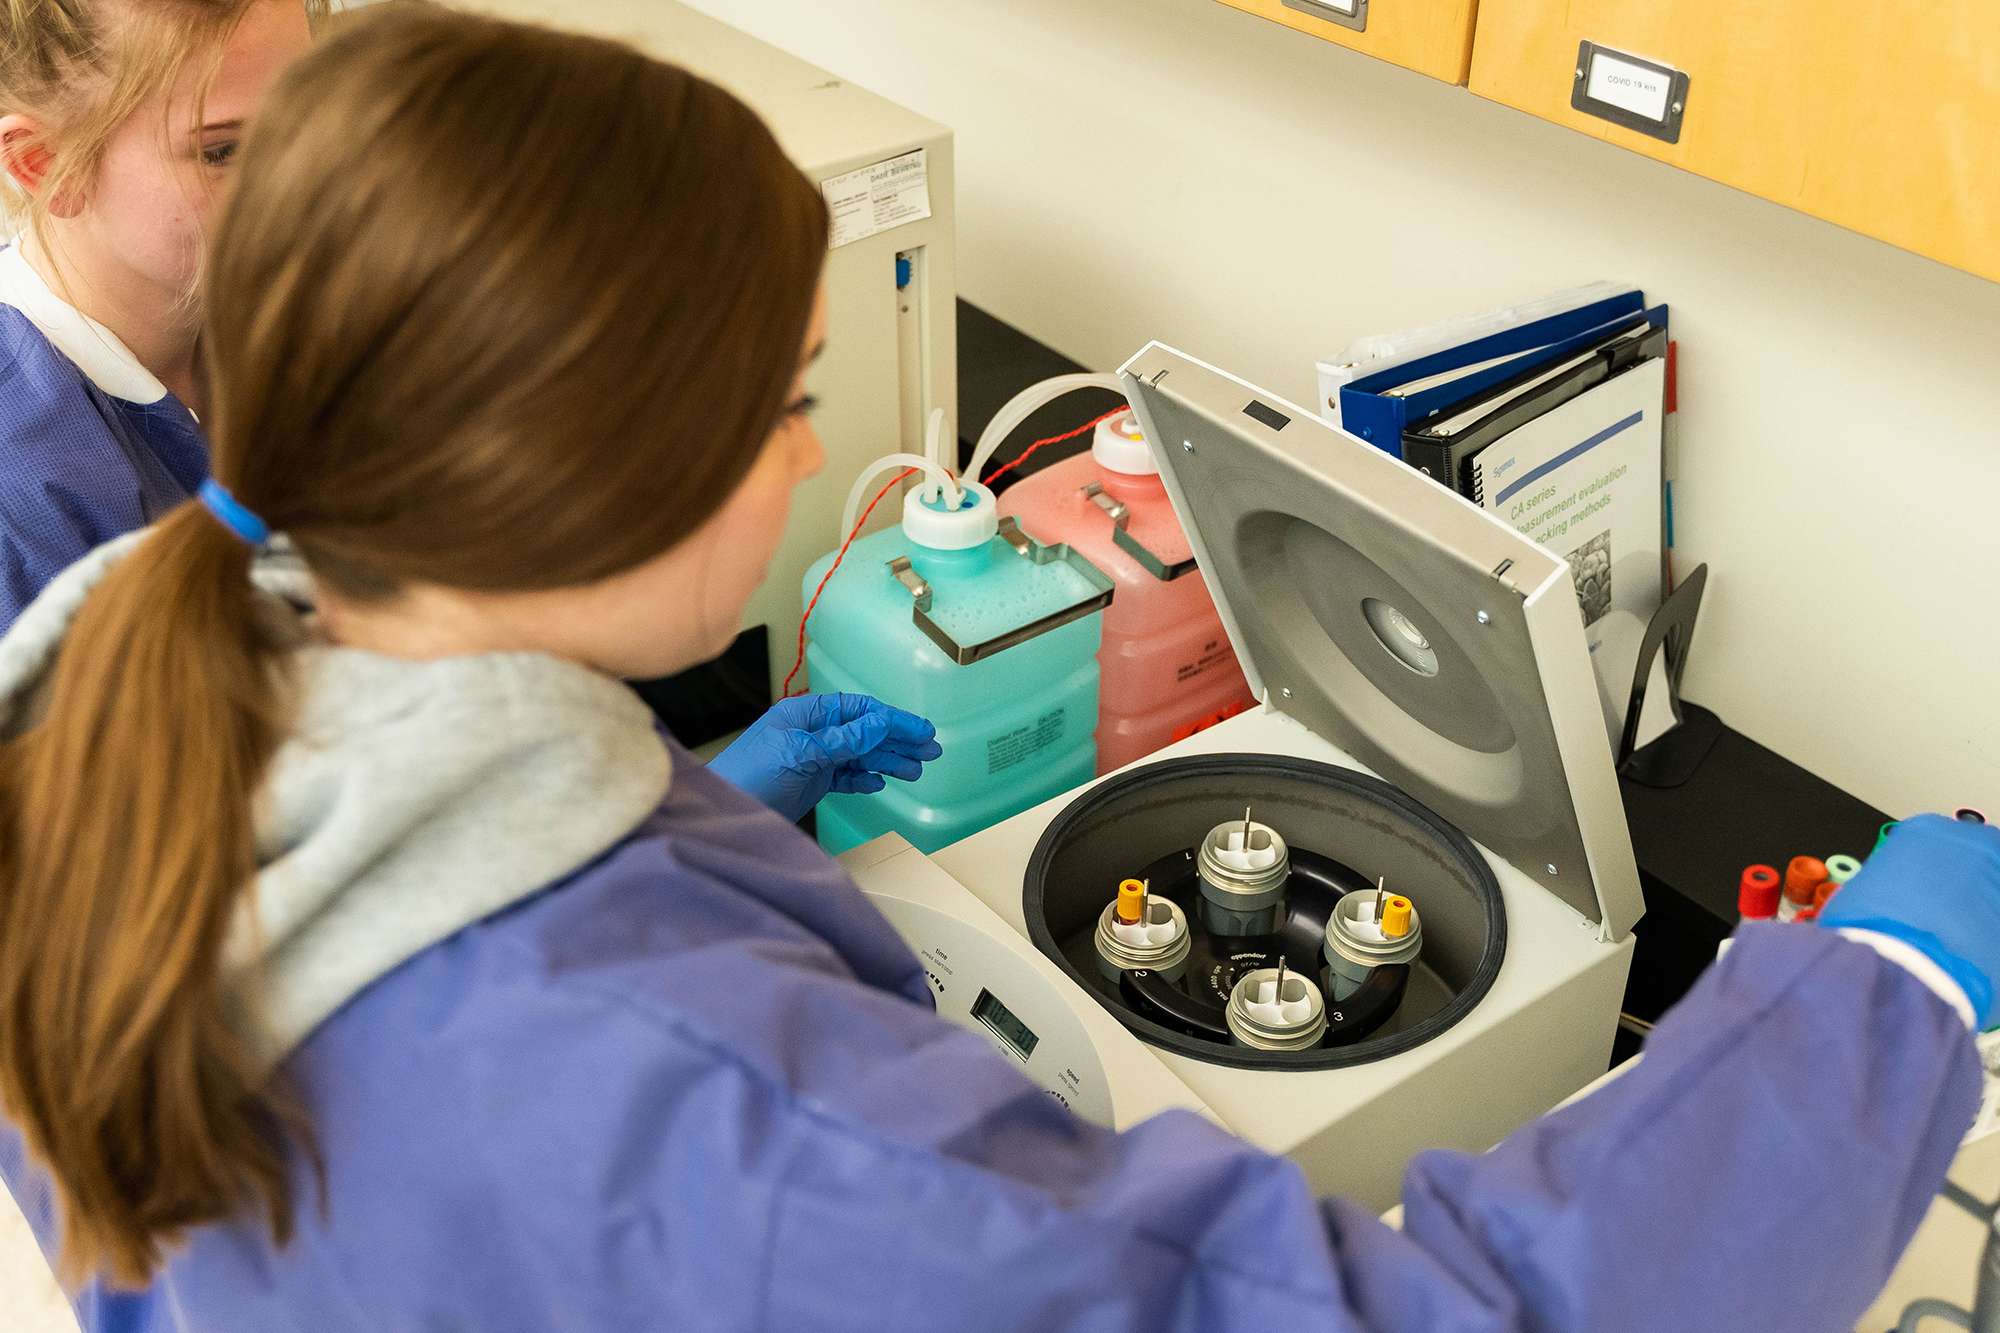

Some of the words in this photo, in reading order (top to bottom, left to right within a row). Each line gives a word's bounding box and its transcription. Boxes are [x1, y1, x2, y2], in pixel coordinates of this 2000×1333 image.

[1607, 75, 1631, 87] COVID
[1633, 81, 1642, 89] 19
[1578, 464, 1628, 501] evaluation
[1510, 502, 1525, 521] CA
[1526, 485, 1557, 511] series
[1535, 520, 1568, 544] ecking
[1569, 494, 1612, 527] methods
[935, 948, 948, 961] time
[1230, 952, 1267, 960] eppendorf
[1135, 970, 1148, 978] 2
[1333, 1011, 1344, 1021] 3
